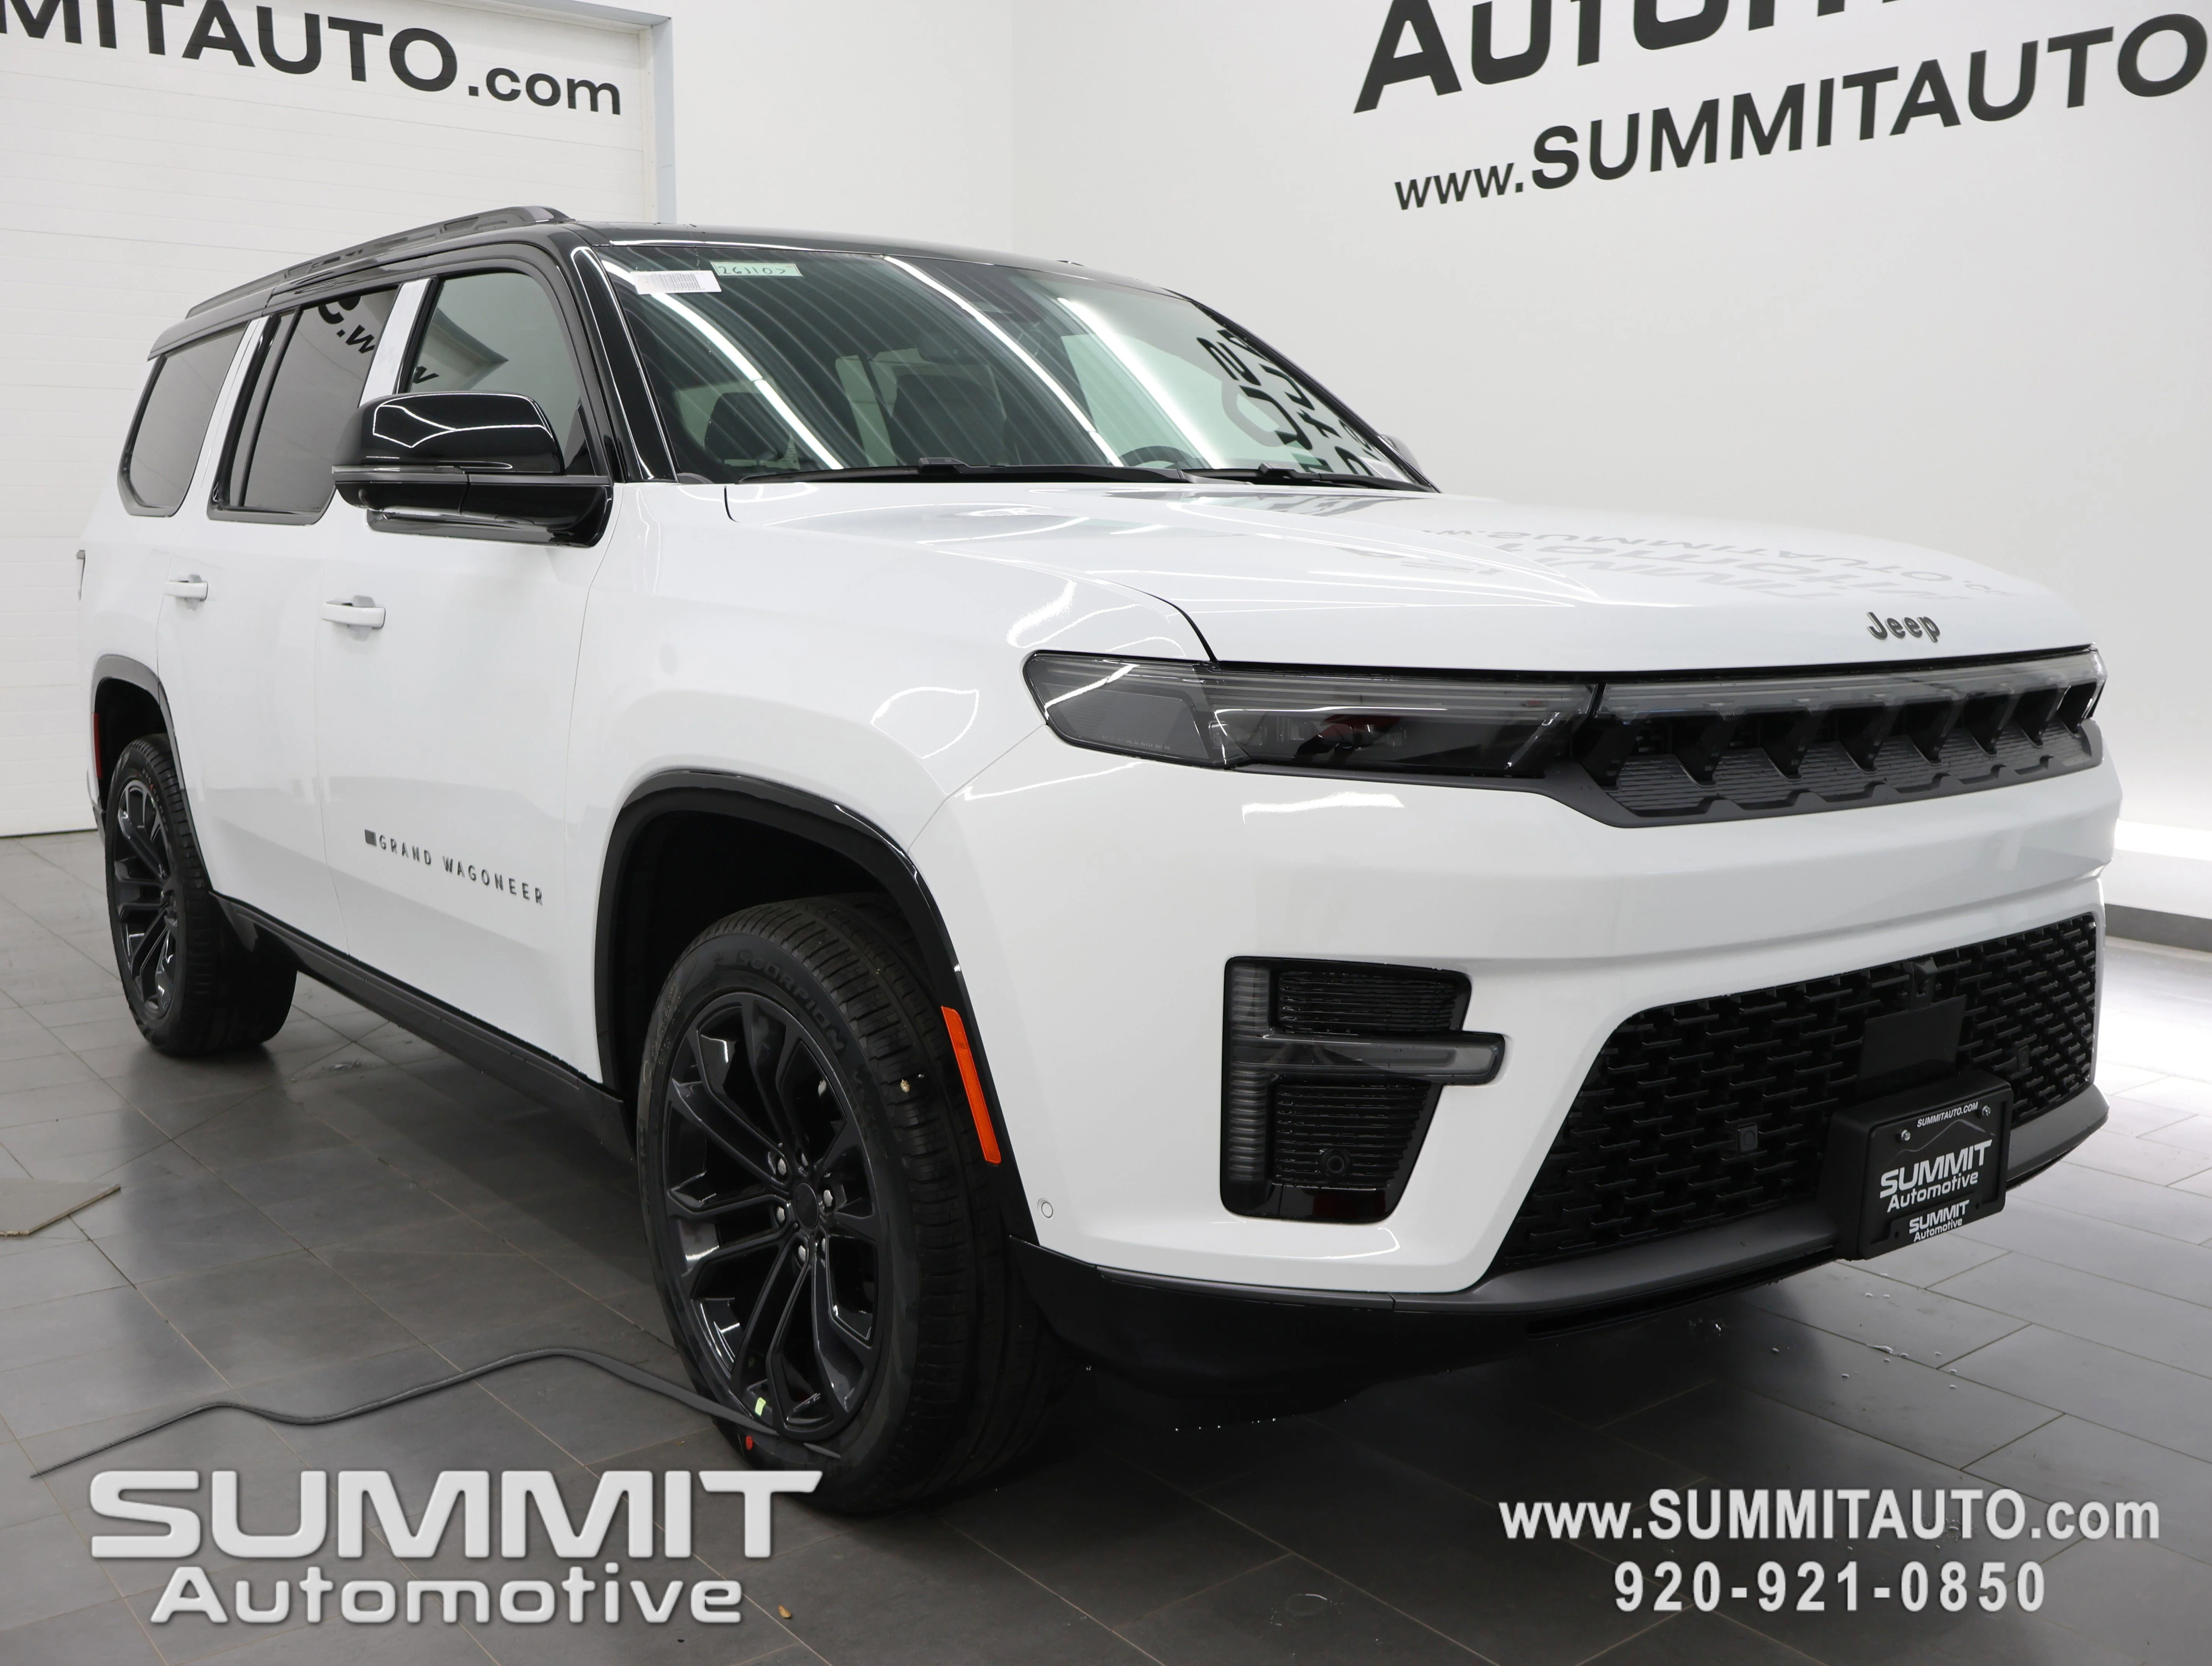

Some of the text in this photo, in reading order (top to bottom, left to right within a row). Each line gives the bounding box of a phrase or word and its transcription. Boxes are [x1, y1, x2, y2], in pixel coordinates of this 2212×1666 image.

[1353, 0, 1908, 113] Auto
[1394, 13, 2207, 211] www.SUMMITAUTO
[1867, 612, 1940, 643] Jeep
[379, 835, 543, 906] GRAND WAGONEER
[1917, 1101, 1979, 1127] SUMMITAUTO.COM
[1880, 1139, 1993, 1199] SUMMIT
[1887, 1171, 1979, 1213] Automotive
[1909, 1199, 1970, 1234] SUMMIT
[1913, 1218, 1963, 1242] Automotive
